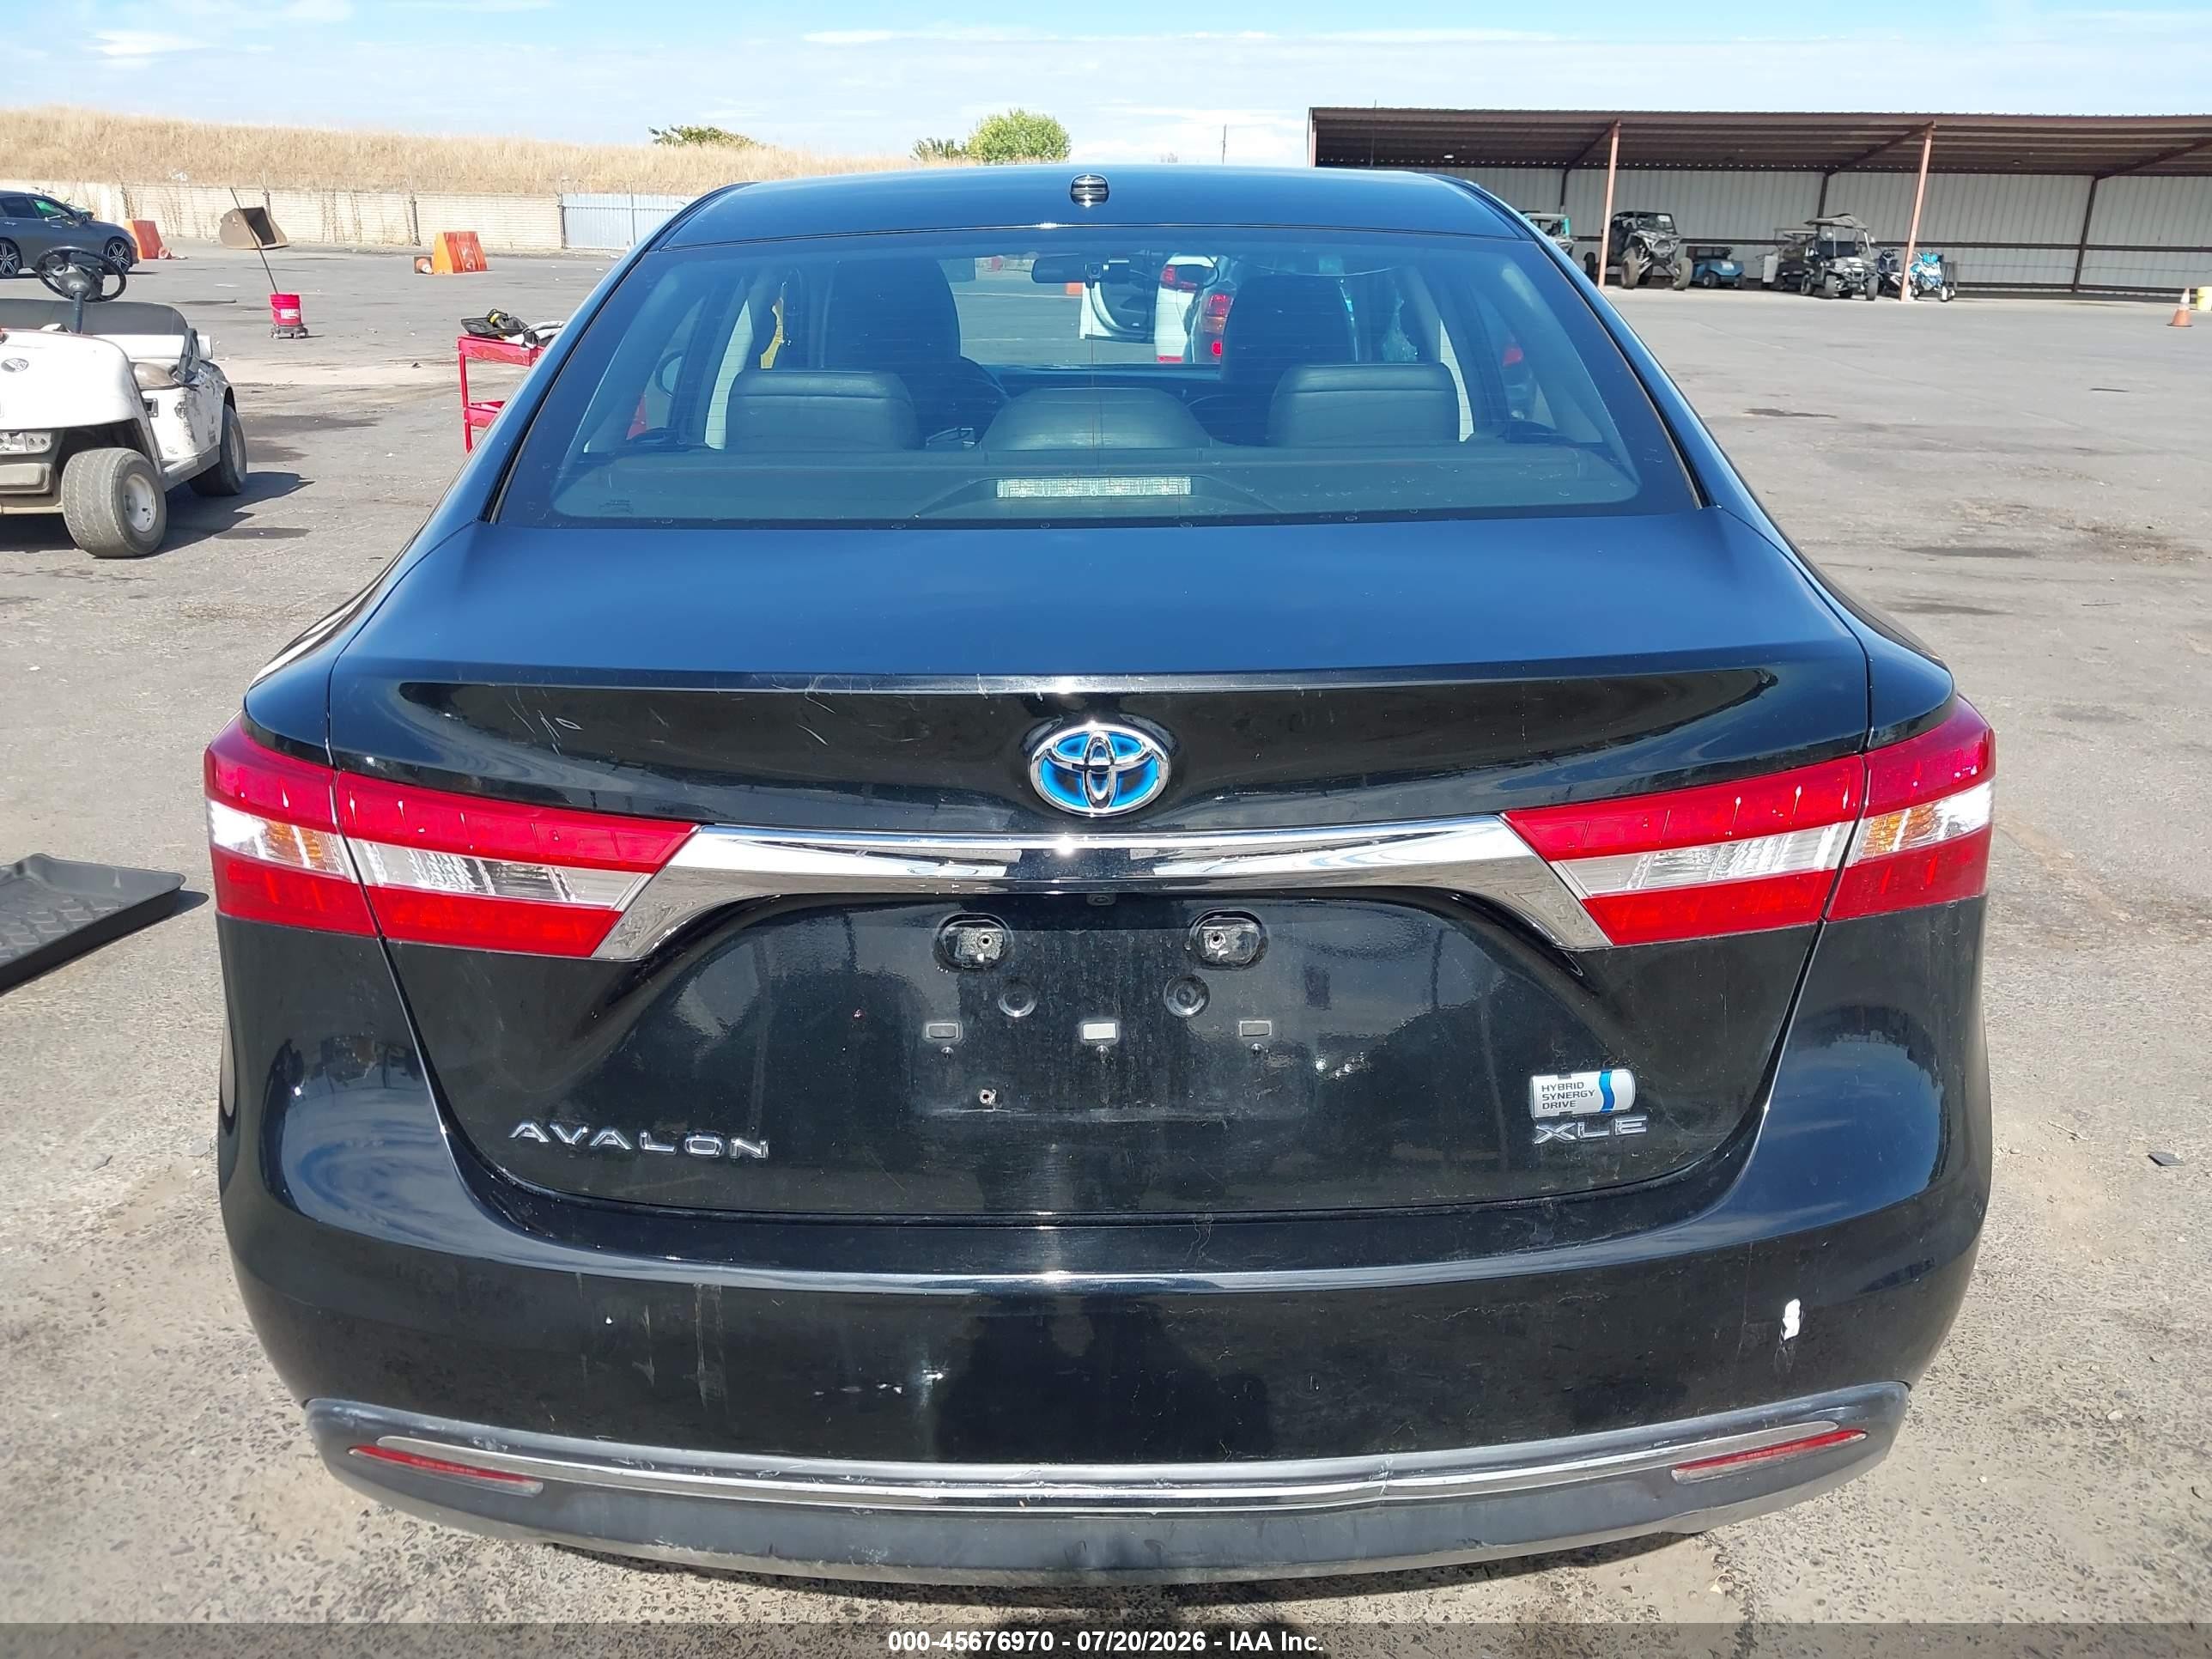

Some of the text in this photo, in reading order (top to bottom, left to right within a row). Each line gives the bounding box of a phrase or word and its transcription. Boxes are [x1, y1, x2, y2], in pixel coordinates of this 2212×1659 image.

[1541, 1081, 1584, 1093] HYBRID
[1541, 1089, 1595, 1102] SYNERGY
[1541, 1100, 1577, 1110] DRIVE
[1532, 1115, 1647, 1146] XLE
[508, 1120, 769, 1159] AVALON
